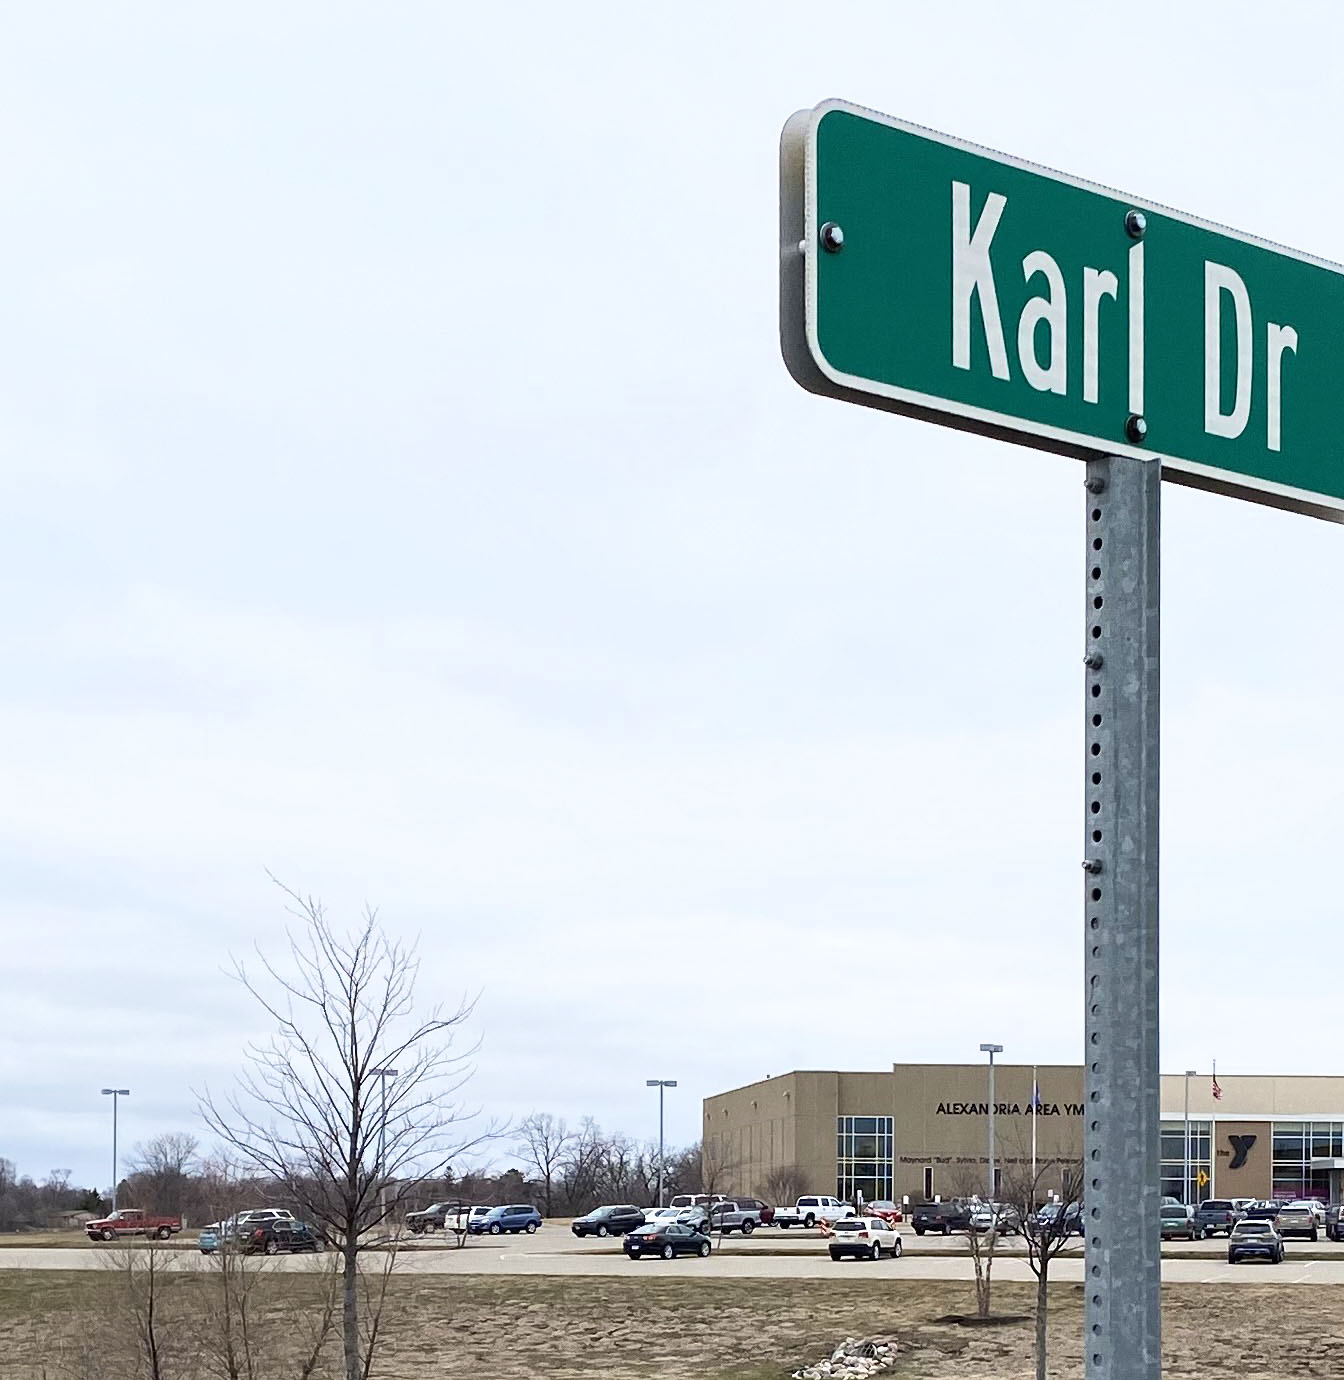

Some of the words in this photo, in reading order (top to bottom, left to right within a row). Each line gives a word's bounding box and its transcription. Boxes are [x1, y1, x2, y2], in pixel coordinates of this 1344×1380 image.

[951, 179, 1145, 417] Karl
[1203, 259, 1299, 453] Dr
[1024, 1103, 1061, 1116] AREA
[1064, 1103, 1085, 1116] YM
